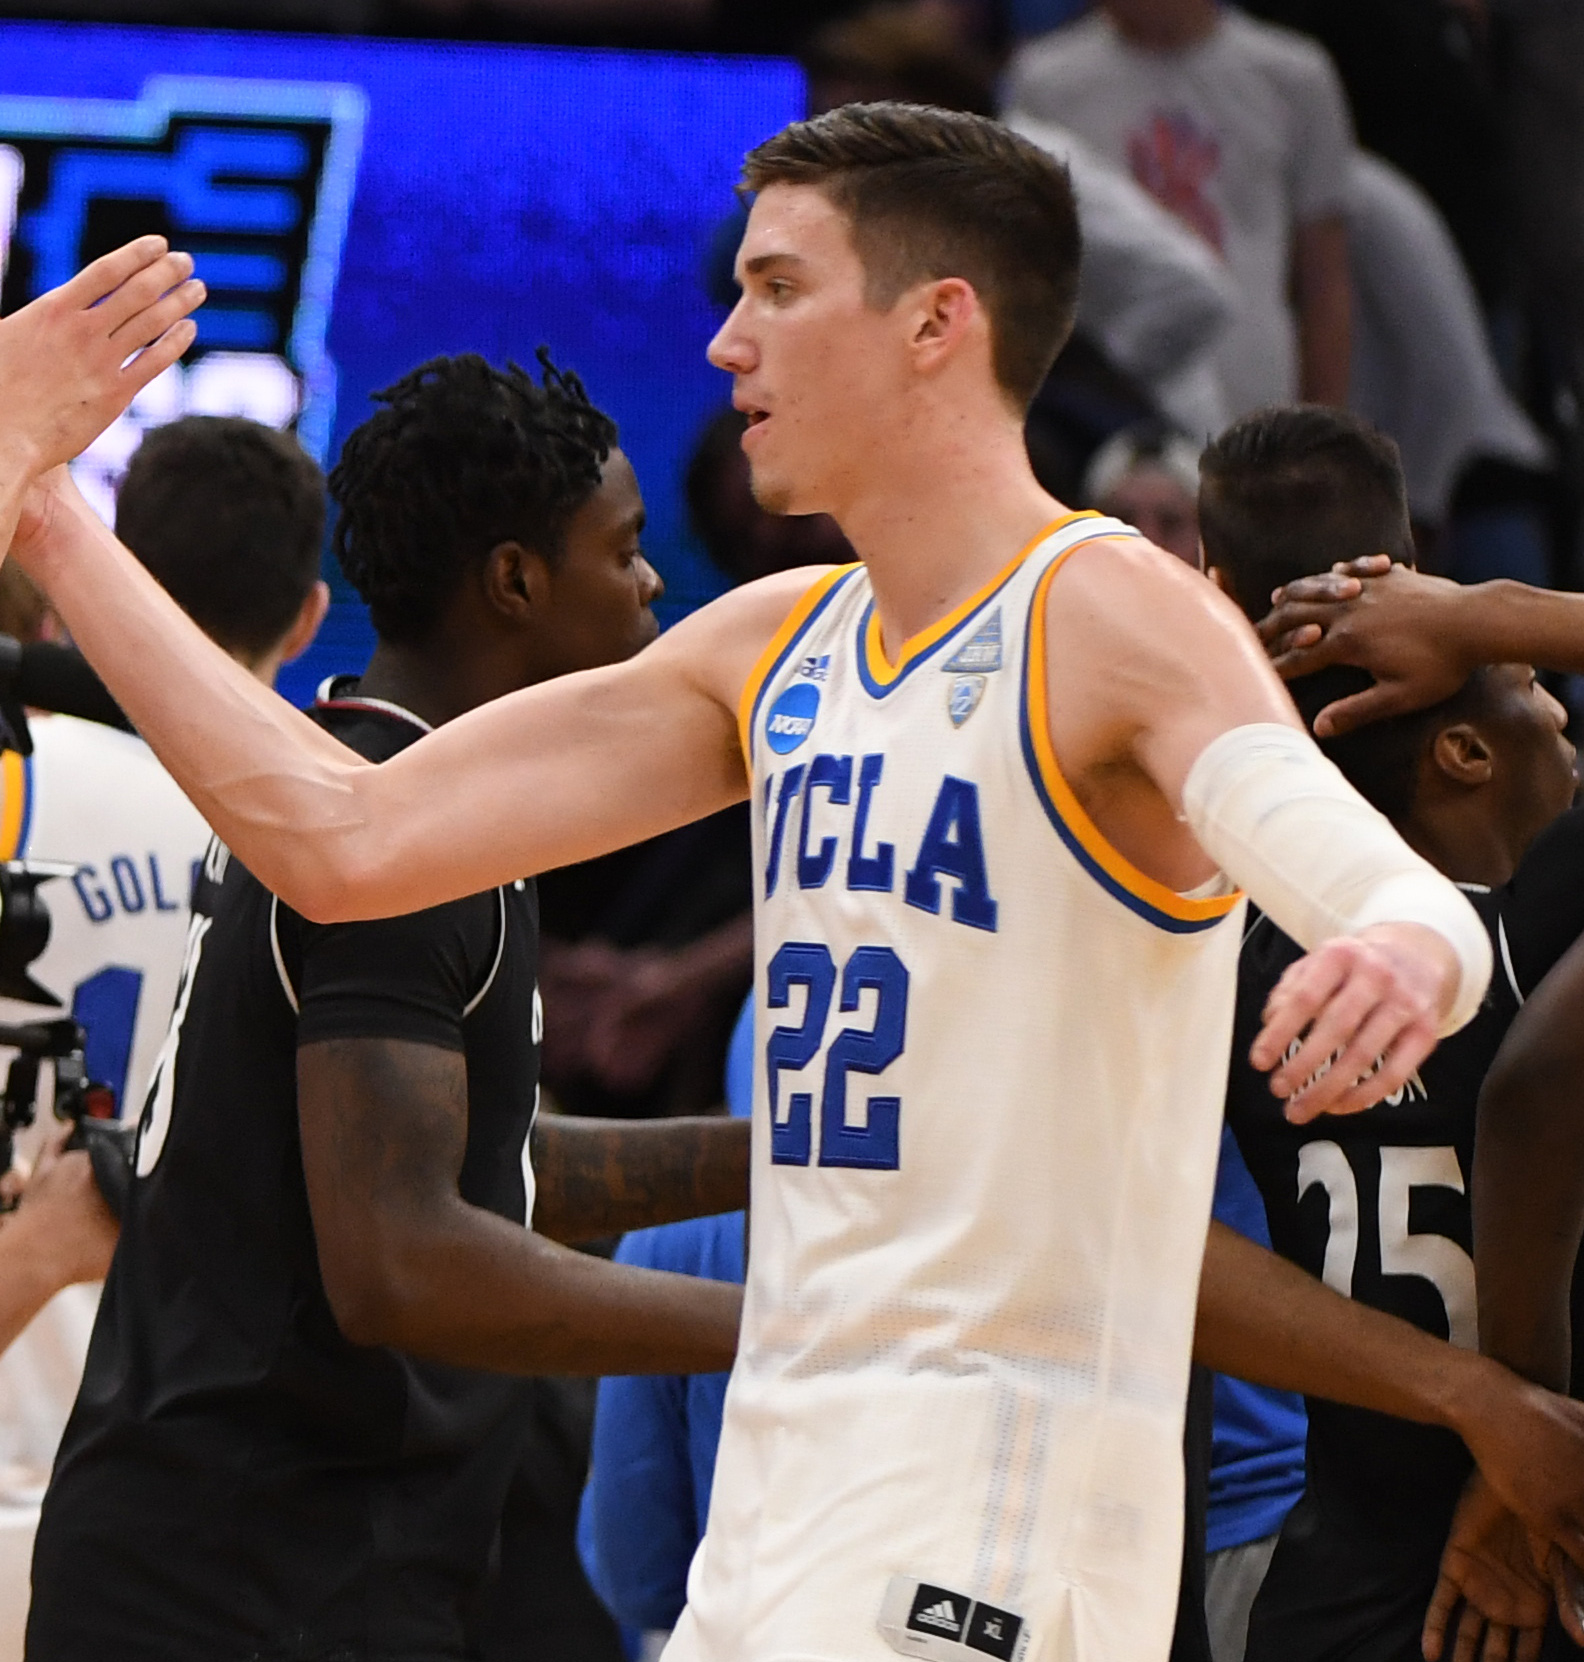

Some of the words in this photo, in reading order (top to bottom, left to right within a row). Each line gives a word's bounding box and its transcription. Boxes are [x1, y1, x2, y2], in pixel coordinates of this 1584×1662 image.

[72, 852, 204, 922] GOL
[764, 753, 998, 933] UCLA
[767, 941, 910, 1170] 22
